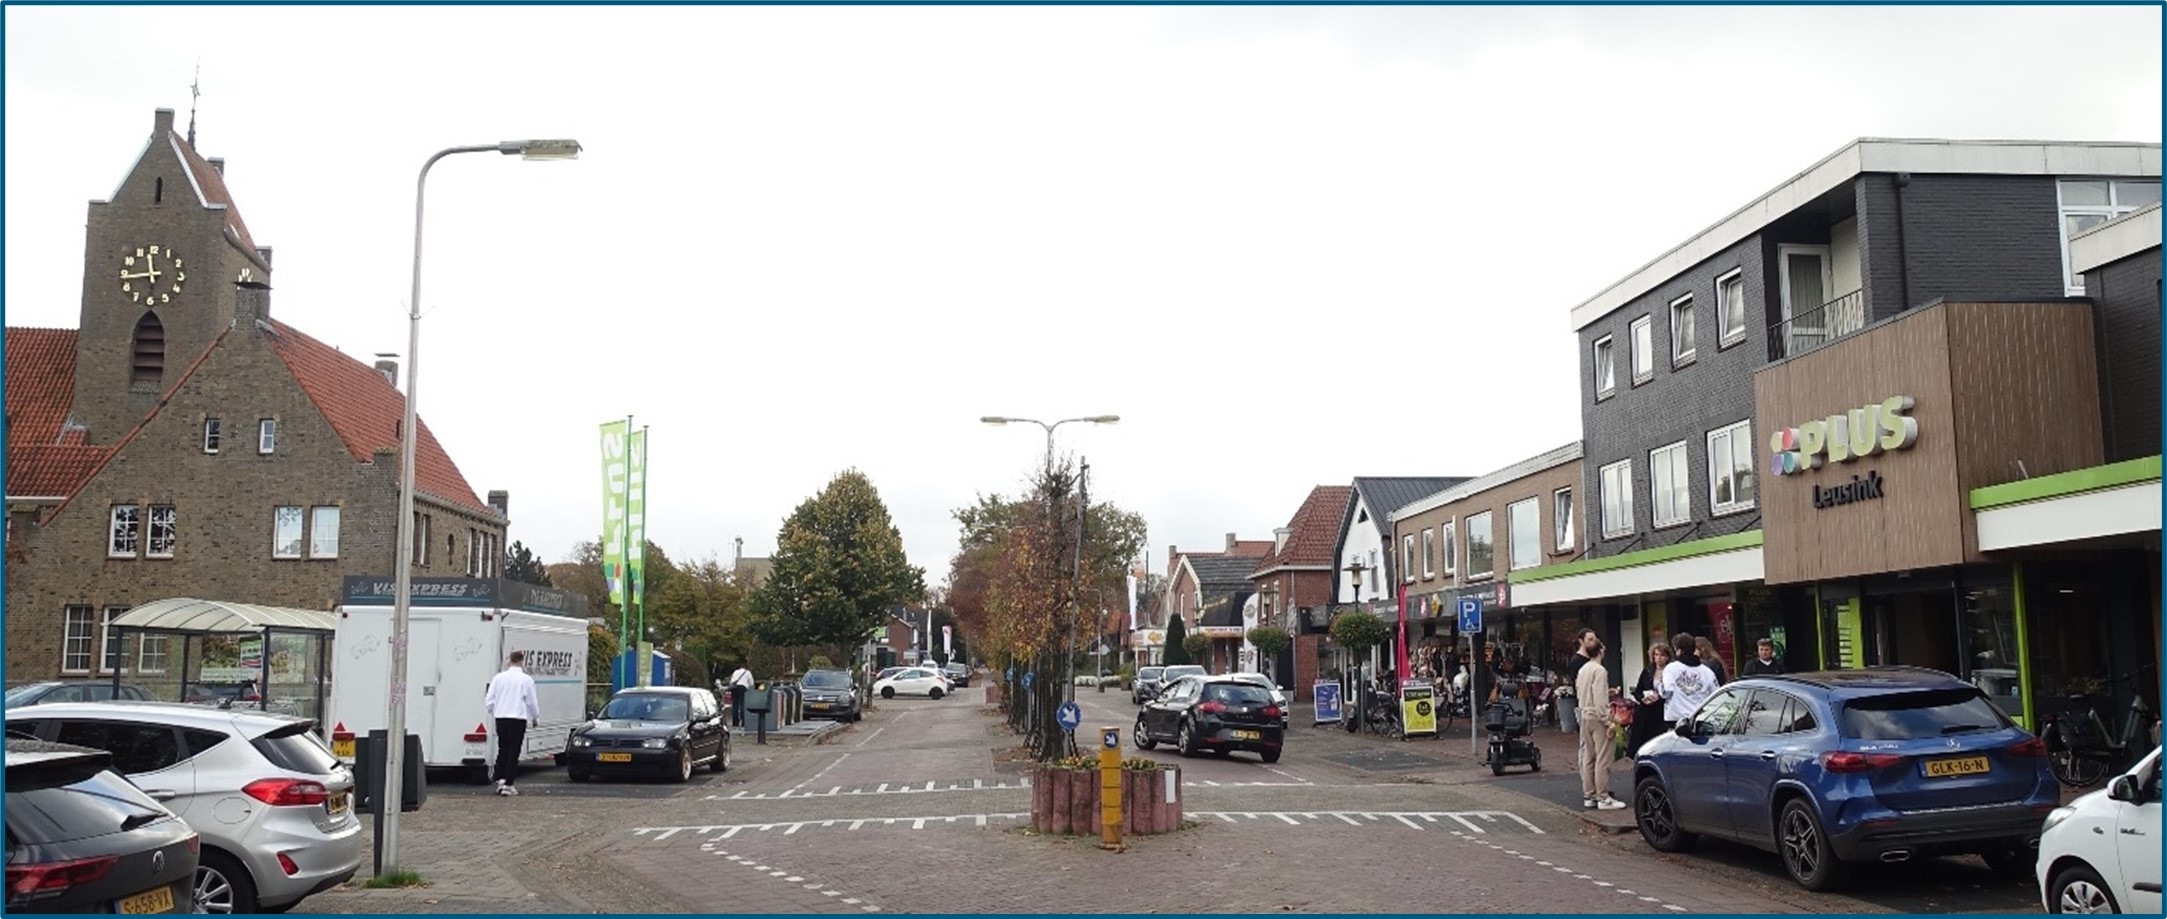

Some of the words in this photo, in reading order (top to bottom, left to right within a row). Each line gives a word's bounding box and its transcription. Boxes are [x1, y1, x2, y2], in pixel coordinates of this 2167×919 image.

[136, 248, 144, 257] 11
[150, 245, 159, 254] 12
[166, 249, 171, 258] 1
[124, 256, 135, 266] 10
[175, 258, 182, 268] 2
[177, 272, 185, 281] 3
[172, 283, 181, 293] 4
[133, 292, 140, 302] 7
[146, 296, 155, 305] 6
[161, 293, 170, 303] 5
[1799, 395, 1918, 470] PLUS
[1812, 470, 1884, 509] Leusink
[407, 584, 468, 595] XPRESS
[1462, 602, 1476, 618] P
[537, 651, 572, 668] EXPRESS
[1931, 759, 1984, 775] GLK-16-N
